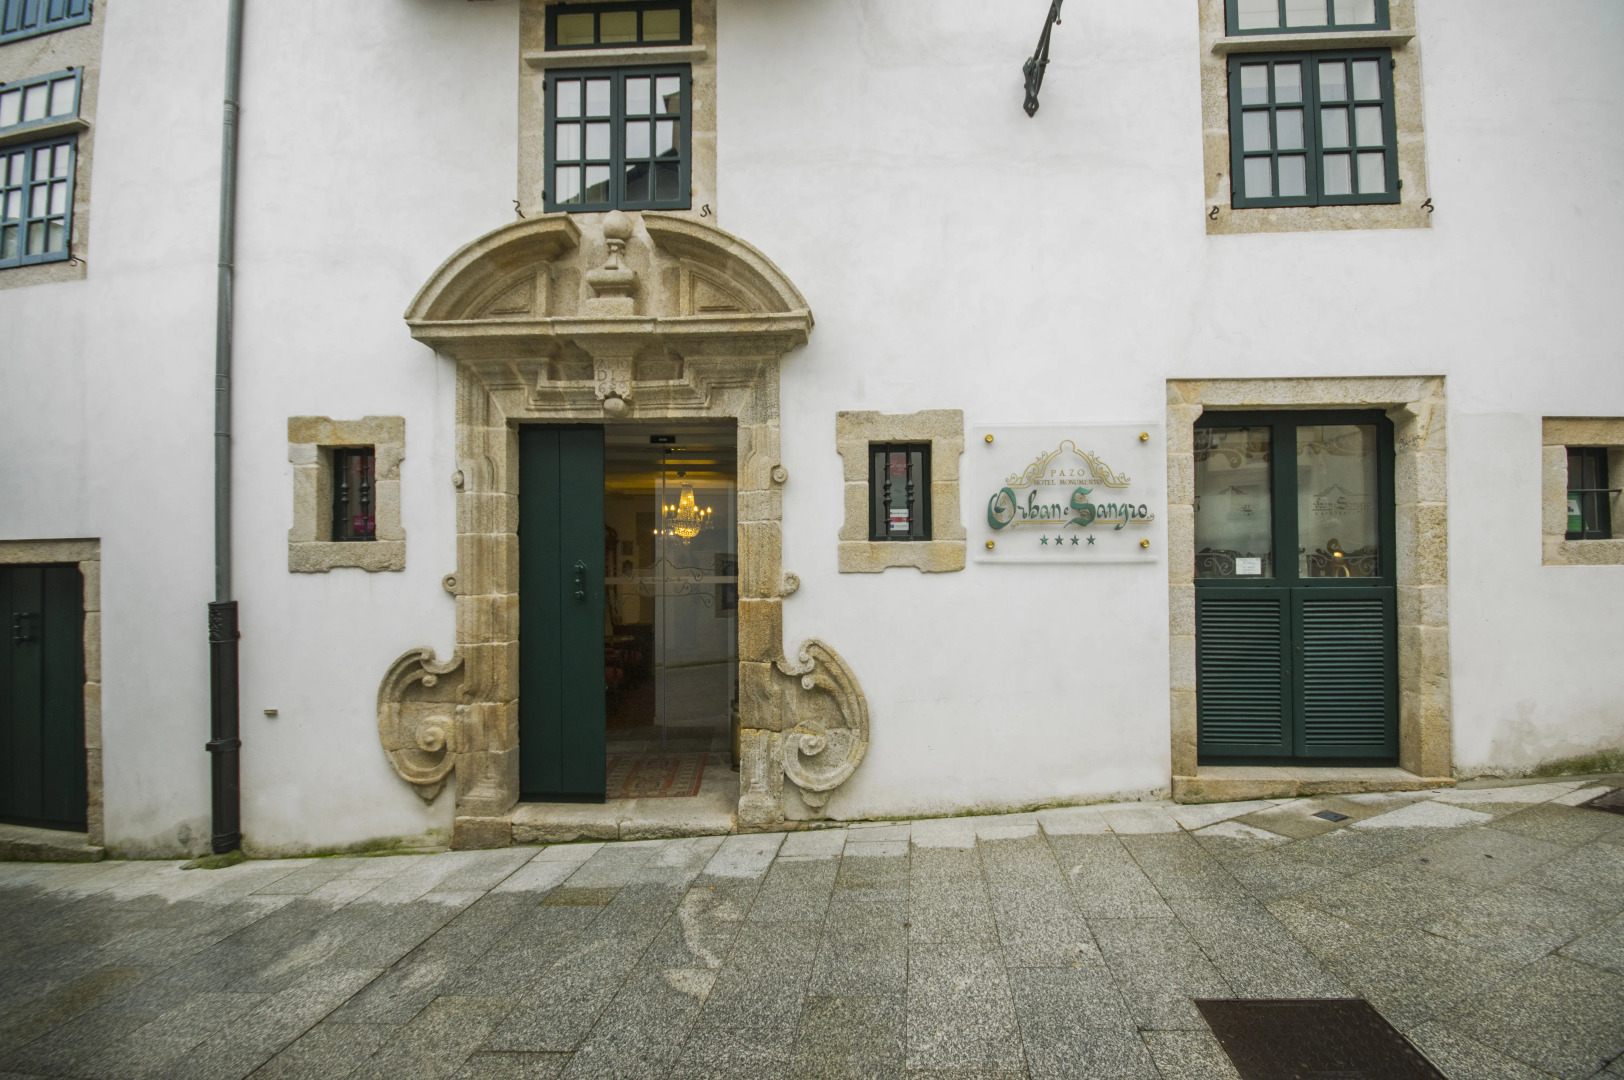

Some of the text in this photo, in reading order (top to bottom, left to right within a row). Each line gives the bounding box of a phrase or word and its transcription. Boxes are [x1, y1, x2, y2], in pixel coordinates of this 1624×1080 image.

[1050, 468, 1085, 477] PAZO
[1033, 478, 1103, 486] HOTEL MONUMENTO
[987, 487, 1061, 530] Orban
[1064, 486, 1148, 531] Sangro
